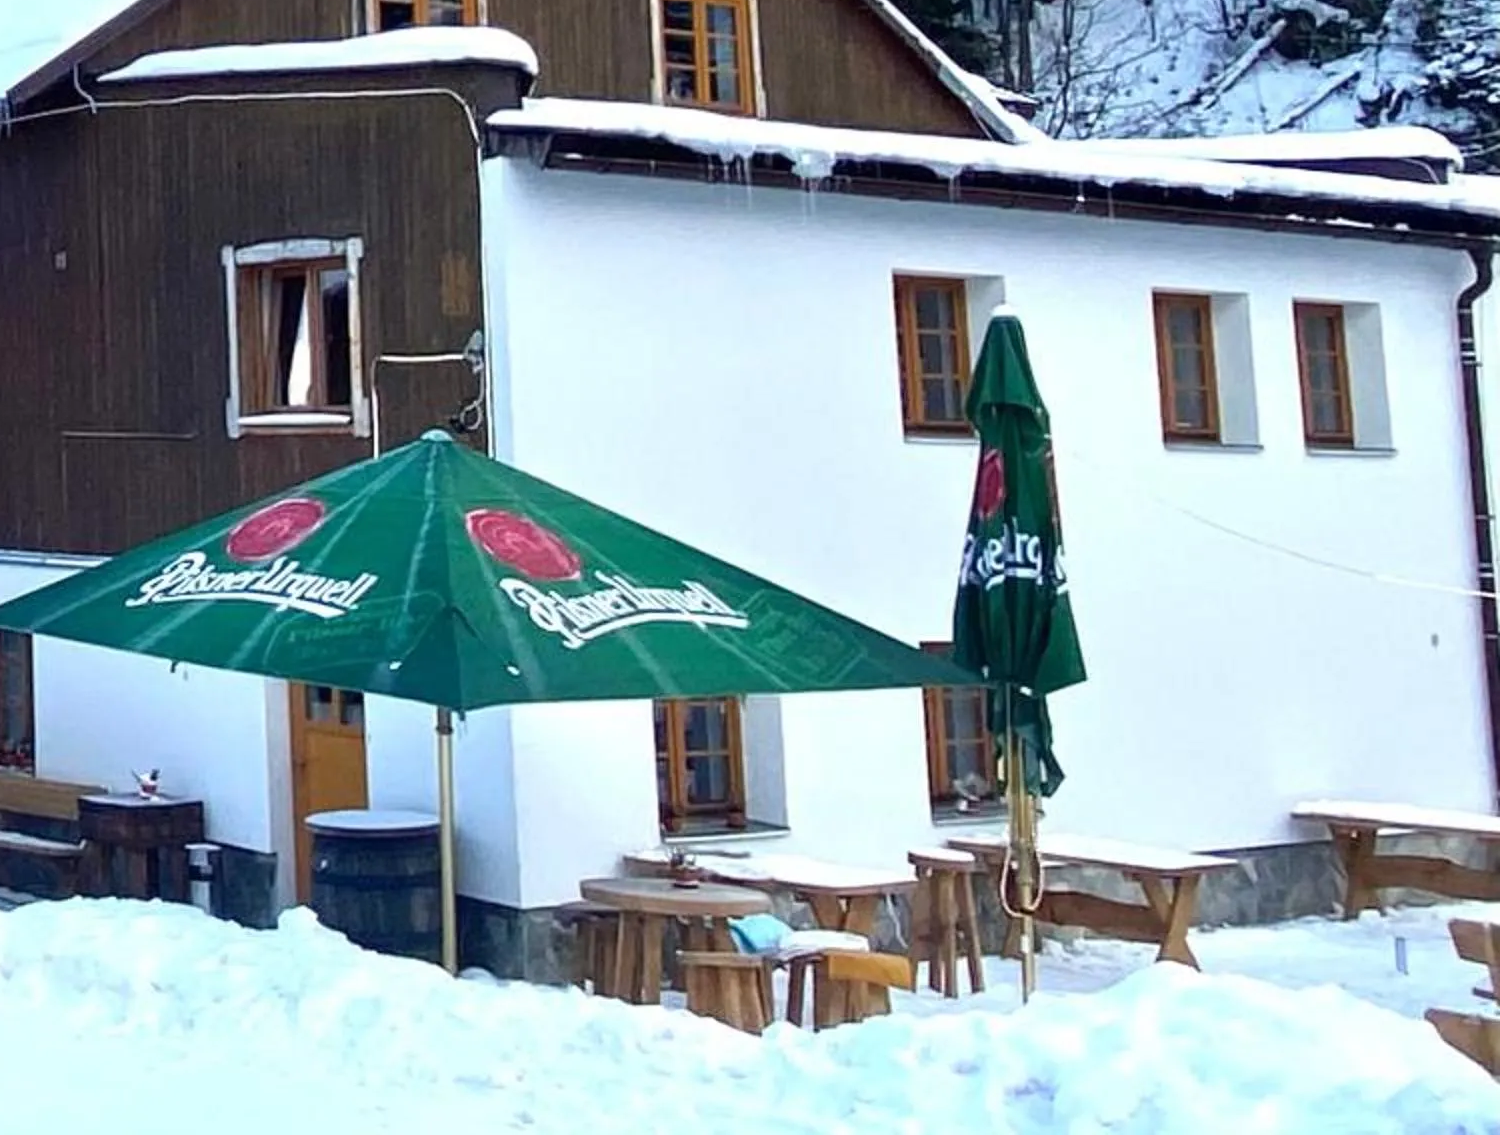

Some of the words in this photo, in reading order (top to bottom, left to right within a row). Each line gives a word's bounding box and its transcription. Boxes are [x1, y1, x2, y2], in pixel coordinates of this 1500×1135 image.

[125, 551, 264, 607] Pilsner
[254, 555, 378, 612] Urquell
[499, 578, 628, 649] Pilsner
[595, 570, 740, 629] Urquell
